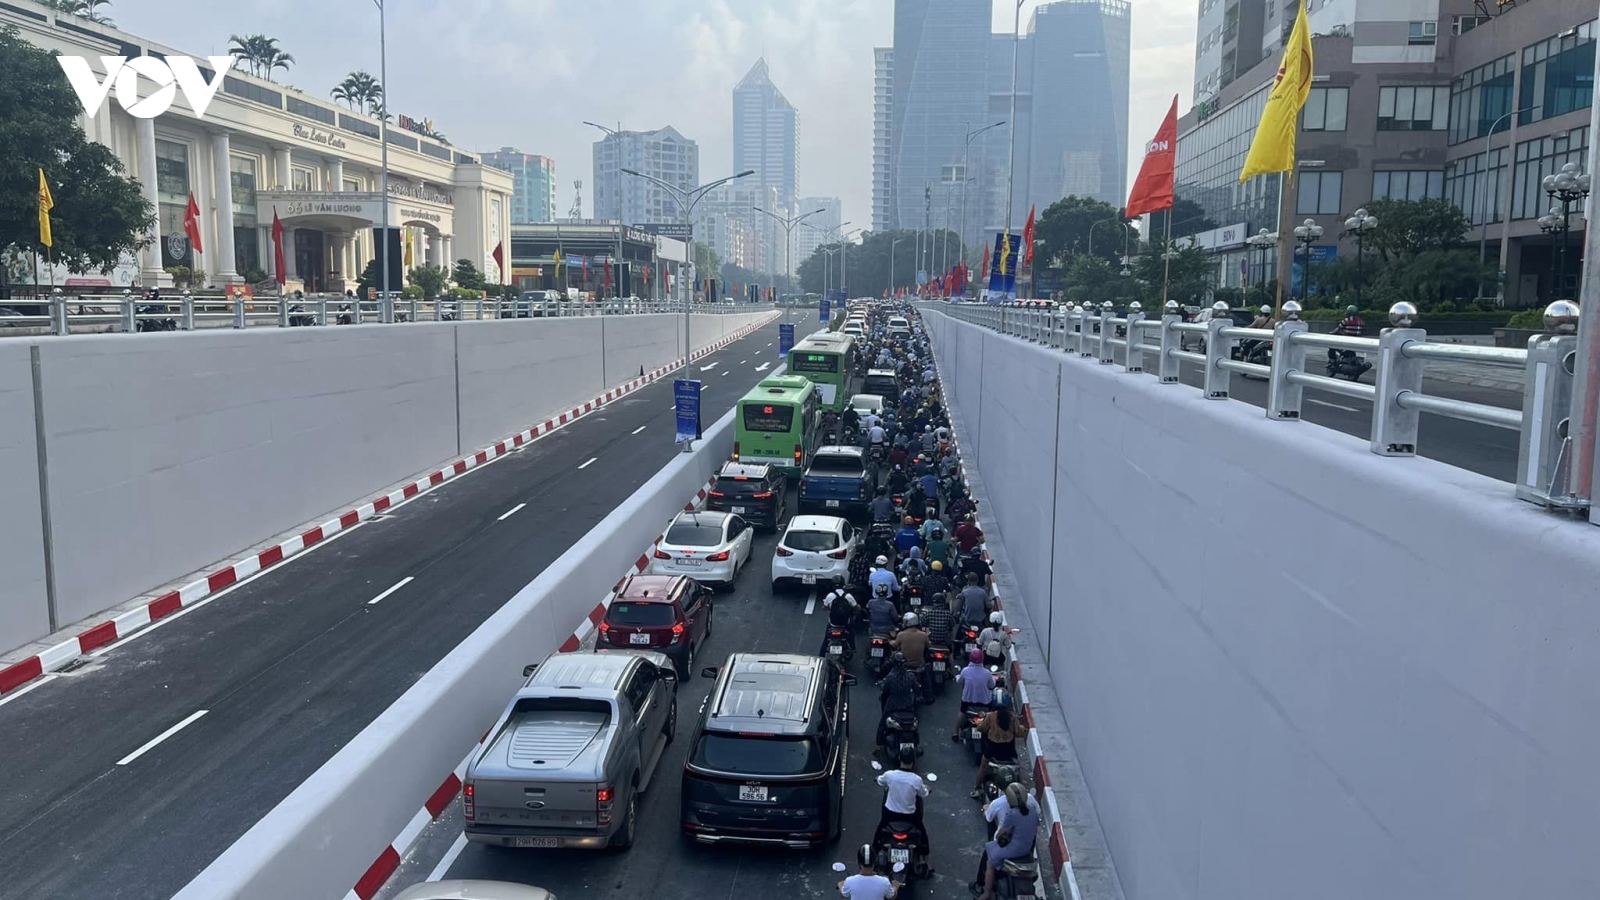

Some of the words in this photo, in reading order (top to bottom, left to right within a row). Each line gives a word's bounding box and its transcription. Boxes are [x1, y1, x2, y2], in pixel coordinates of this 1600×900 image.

[293, 123, 309, 139] Blue
[309, 127, 327, 143] Lotus
[328, 133, 346, 149] Center
[1148, 140, 1169, 152] ON
[287, 202, 303, 214] 66
[304, 202, 313, 212] LÊ
[315, 203, 332, 212] VĂN
[479, 811, 593, 823] RANGER
